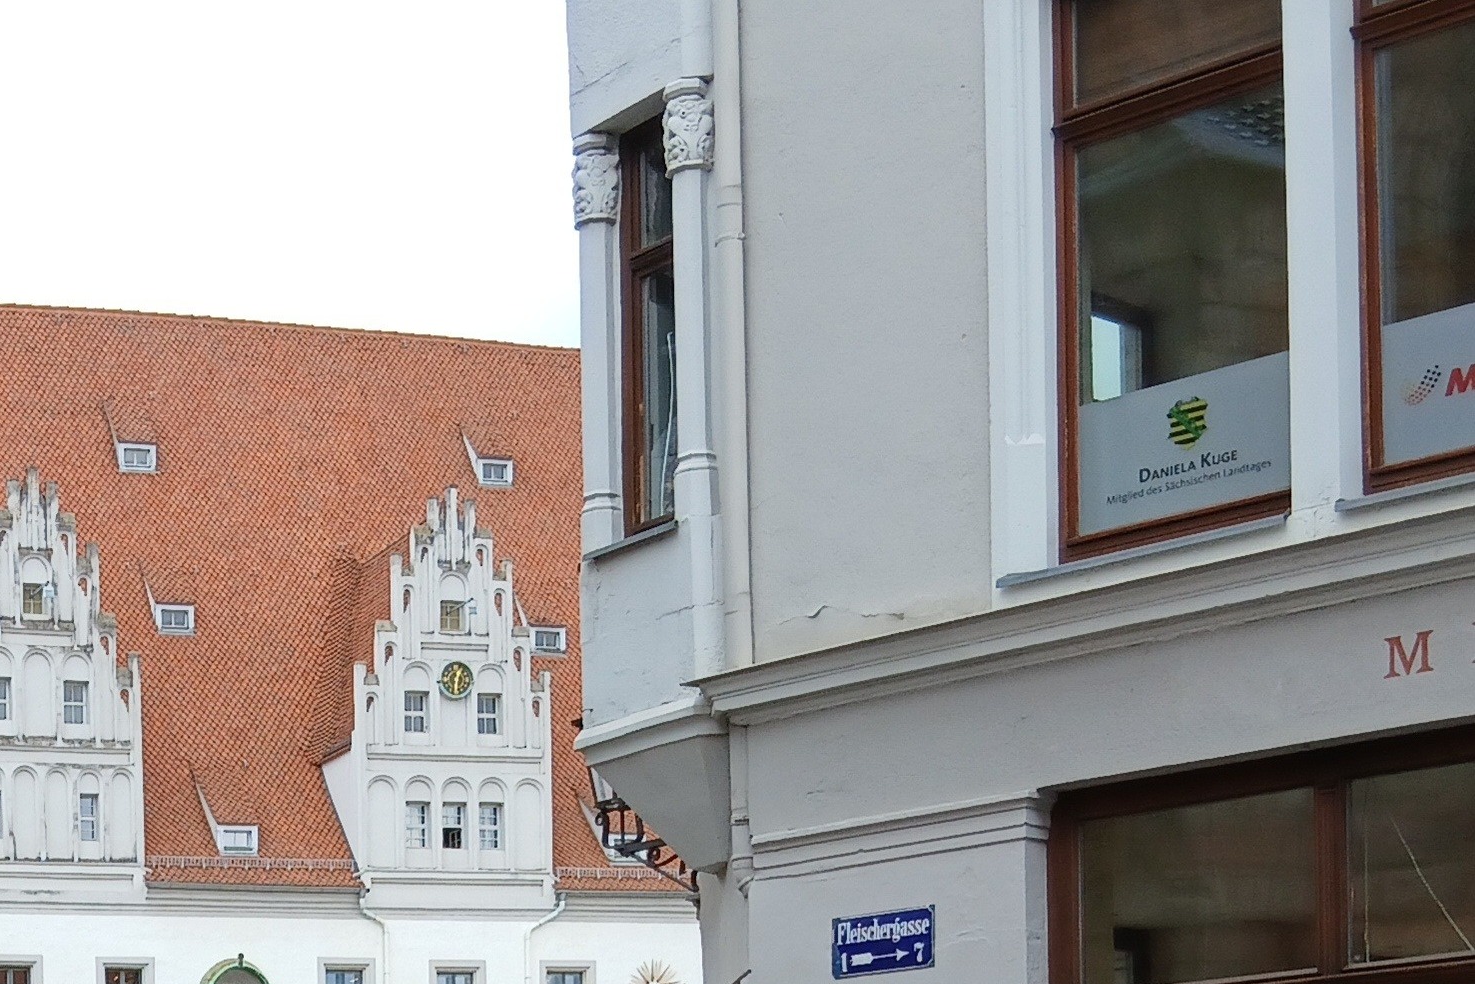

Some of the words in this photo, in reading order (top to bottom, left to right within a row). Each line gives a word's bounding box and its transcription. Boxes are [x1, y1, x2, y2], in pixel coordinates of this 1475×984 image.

[1106, 489, 1145, 505] Mitglied
[1146, 484, 1163, 496] des
[1165, 471, 1221, 491] Sächsischen
[1223, 459, 1272, 479] Landtages
[836, 916, 930, 946] Fleischergasse
[840, 952, 848, 973] 1
[913, 942, 925, 963] 7
